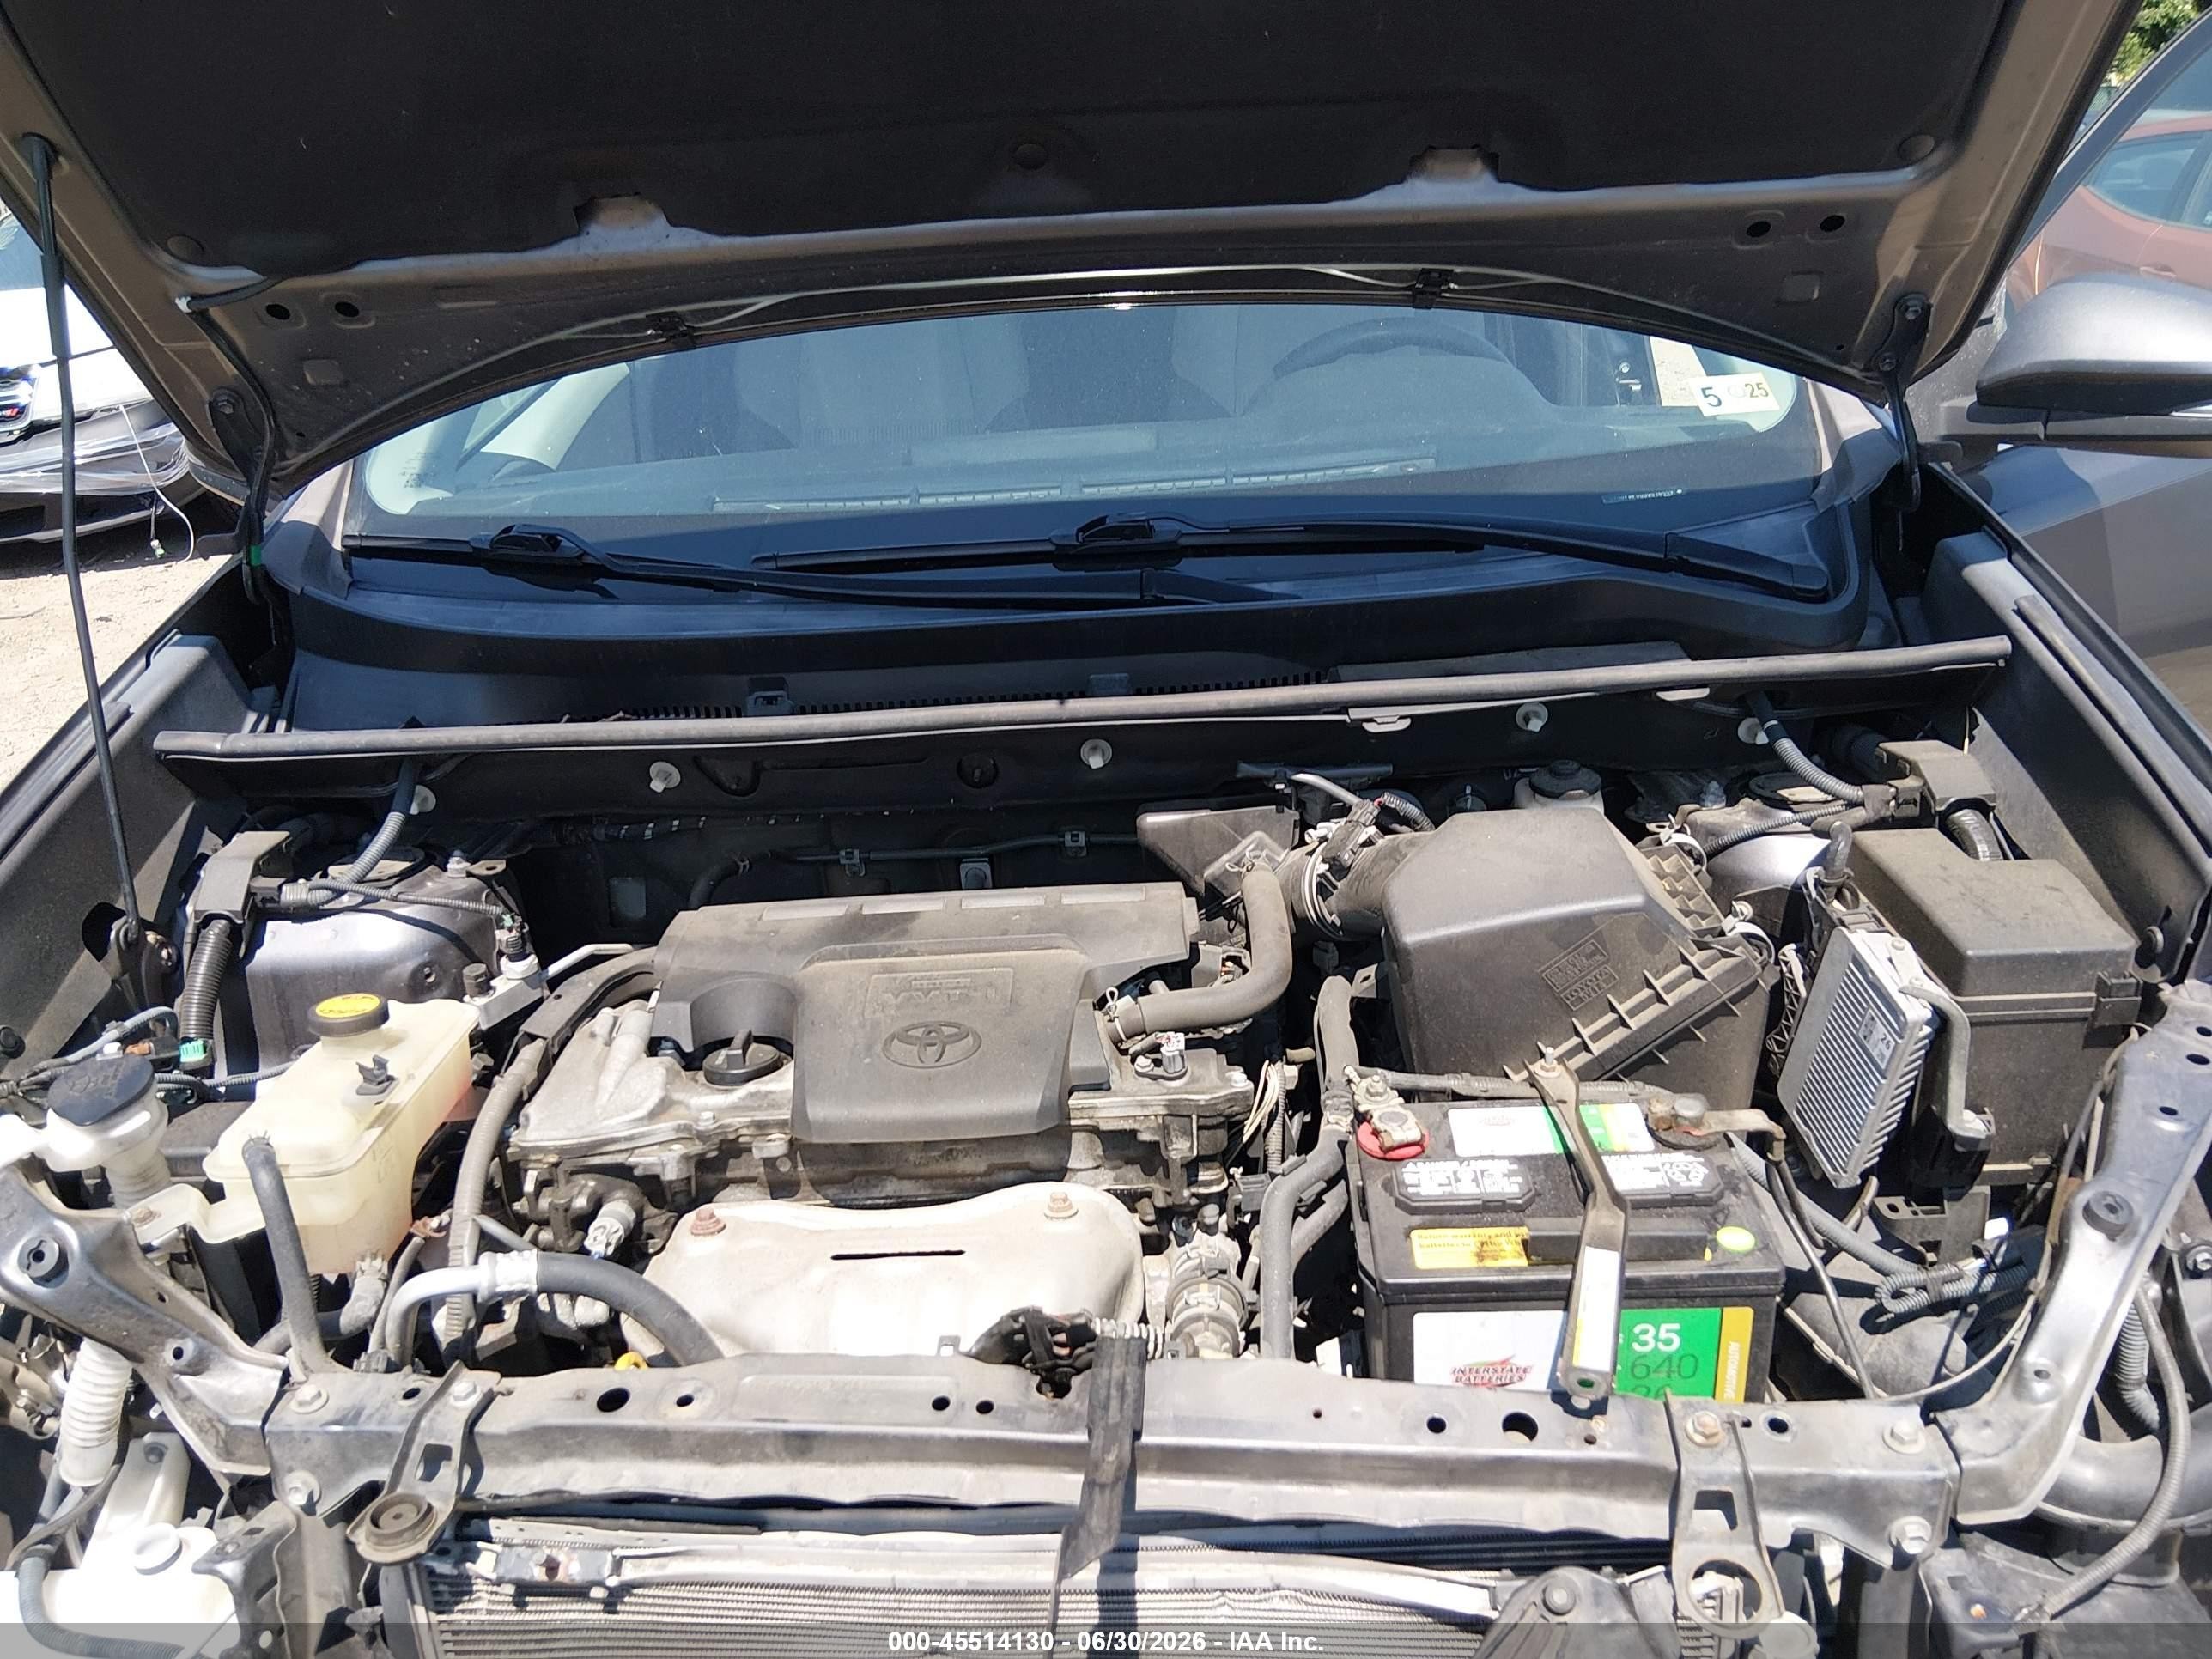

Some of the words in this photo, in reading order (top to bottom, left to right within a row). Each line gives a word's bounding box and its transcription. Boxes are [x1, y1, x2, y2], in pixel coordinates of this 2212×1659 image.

[1701, 387, 1723, 407] 5
[1744, 382, 1770, 398] 25
[1565, 967, 1609, 1001] TOYOTA
[1631, 1322, 1681, 1352] 35
[1450, 1366, 1531, 1375] INTERSTATE
[1455, 1374, 1525, 1382] BATTERIES
[1630, 1353, 1699, 1380] 640
[1723, 1340, 1741, 1400] AUTOMOTIVE
